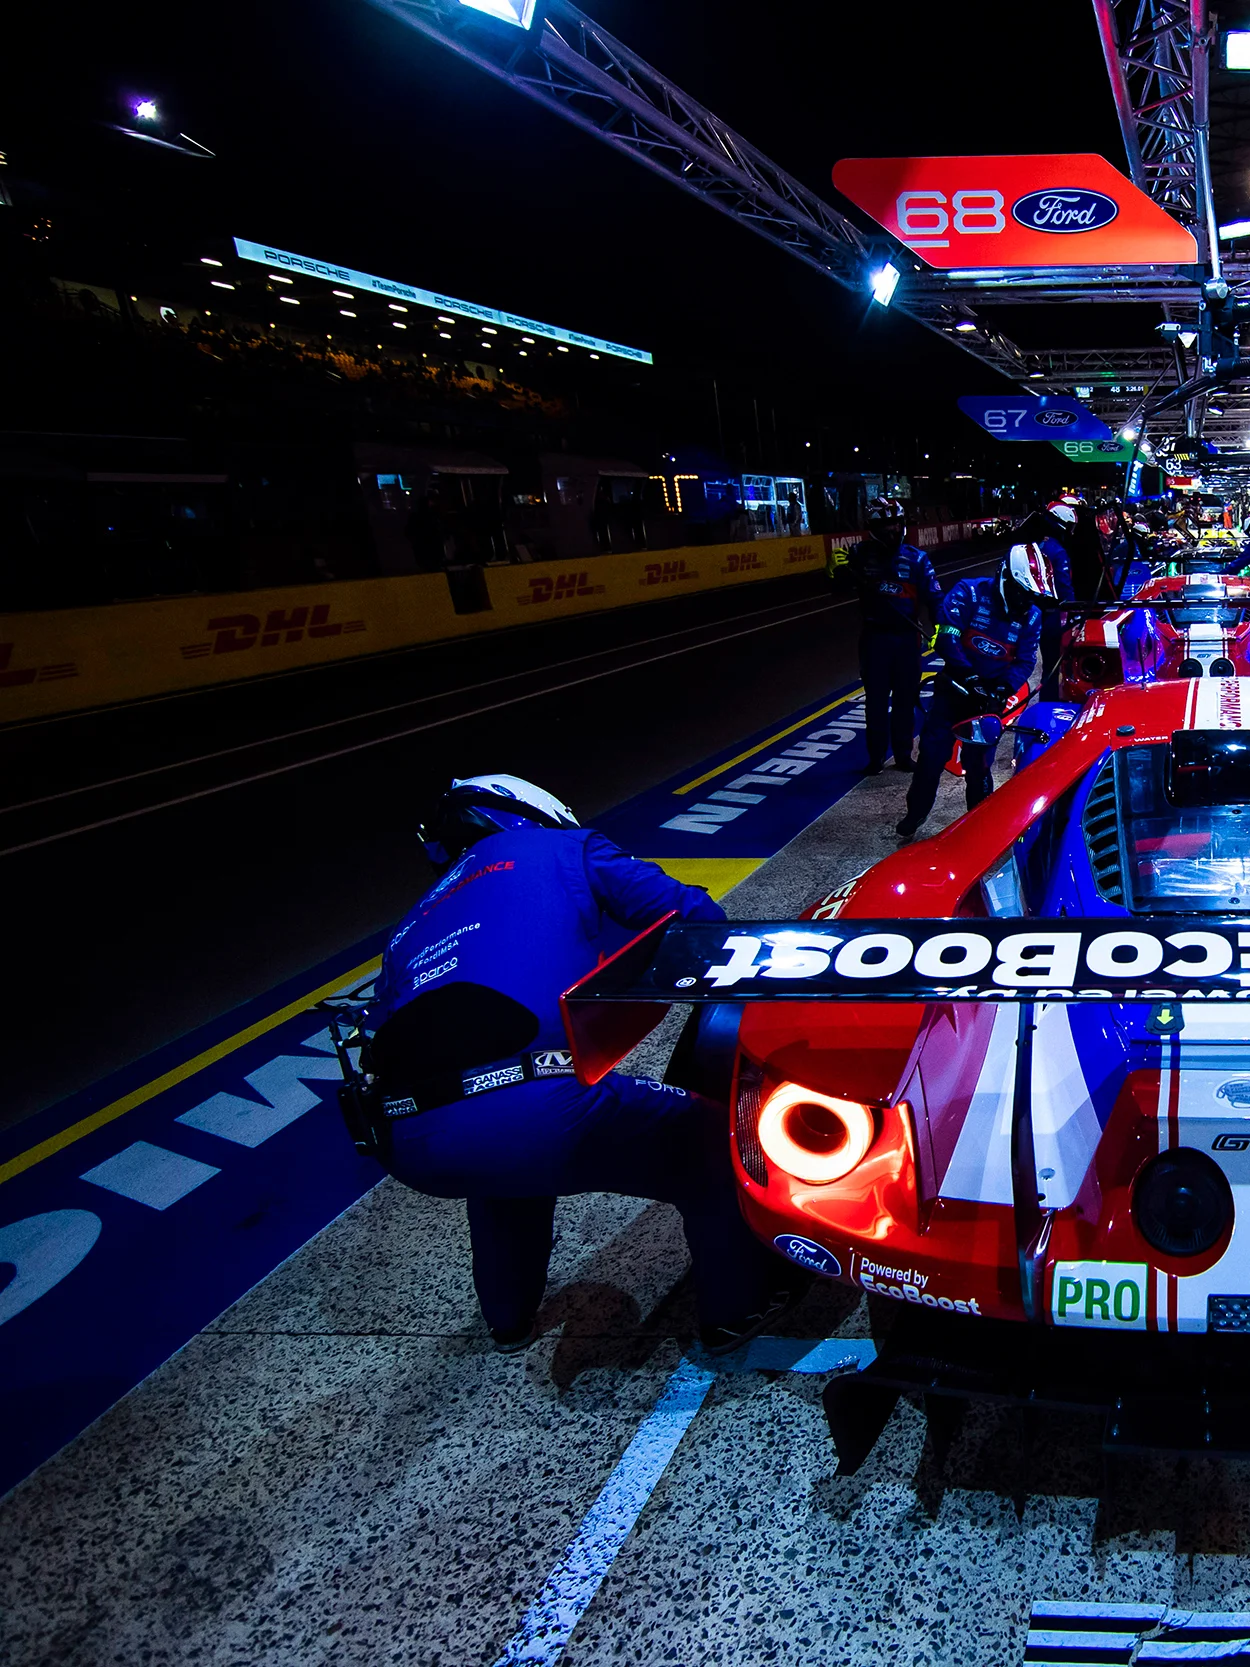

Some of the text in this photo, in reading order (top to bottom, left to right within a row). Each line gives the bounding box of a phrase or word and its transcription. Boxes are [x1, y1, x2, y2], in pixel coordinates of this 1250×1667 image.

[896, 189, 1098, 235] 68 Ford
[264, 250, 350, 281] PORSCHE
[372, 280, 416, 299] #TeamPorsche
[434, 297, 493, 319] PORSCHE
[507, 316, 556, 336] PORSCHE
[984, 410, 1070, 427] 67 Ford
[1064, 441, 1120, 454] 66 Ford
[529, 573, 595, 603] DHL
[643, 560, 692, 585] DHL
[207, 605, 342, 654] DHL
[978, 641, 1001, 656] Ford
[473, 1067, 521, 1087] GANASSI
[635, 1079, 687, 1097] FORD
[787, 1239, 828, 1272] Ford
[861, 1257, 929, 1289] Powered by
[859, 1272, 982, 1316] EcoBoost
[1057, 1277, 1141, 1321] PRO
